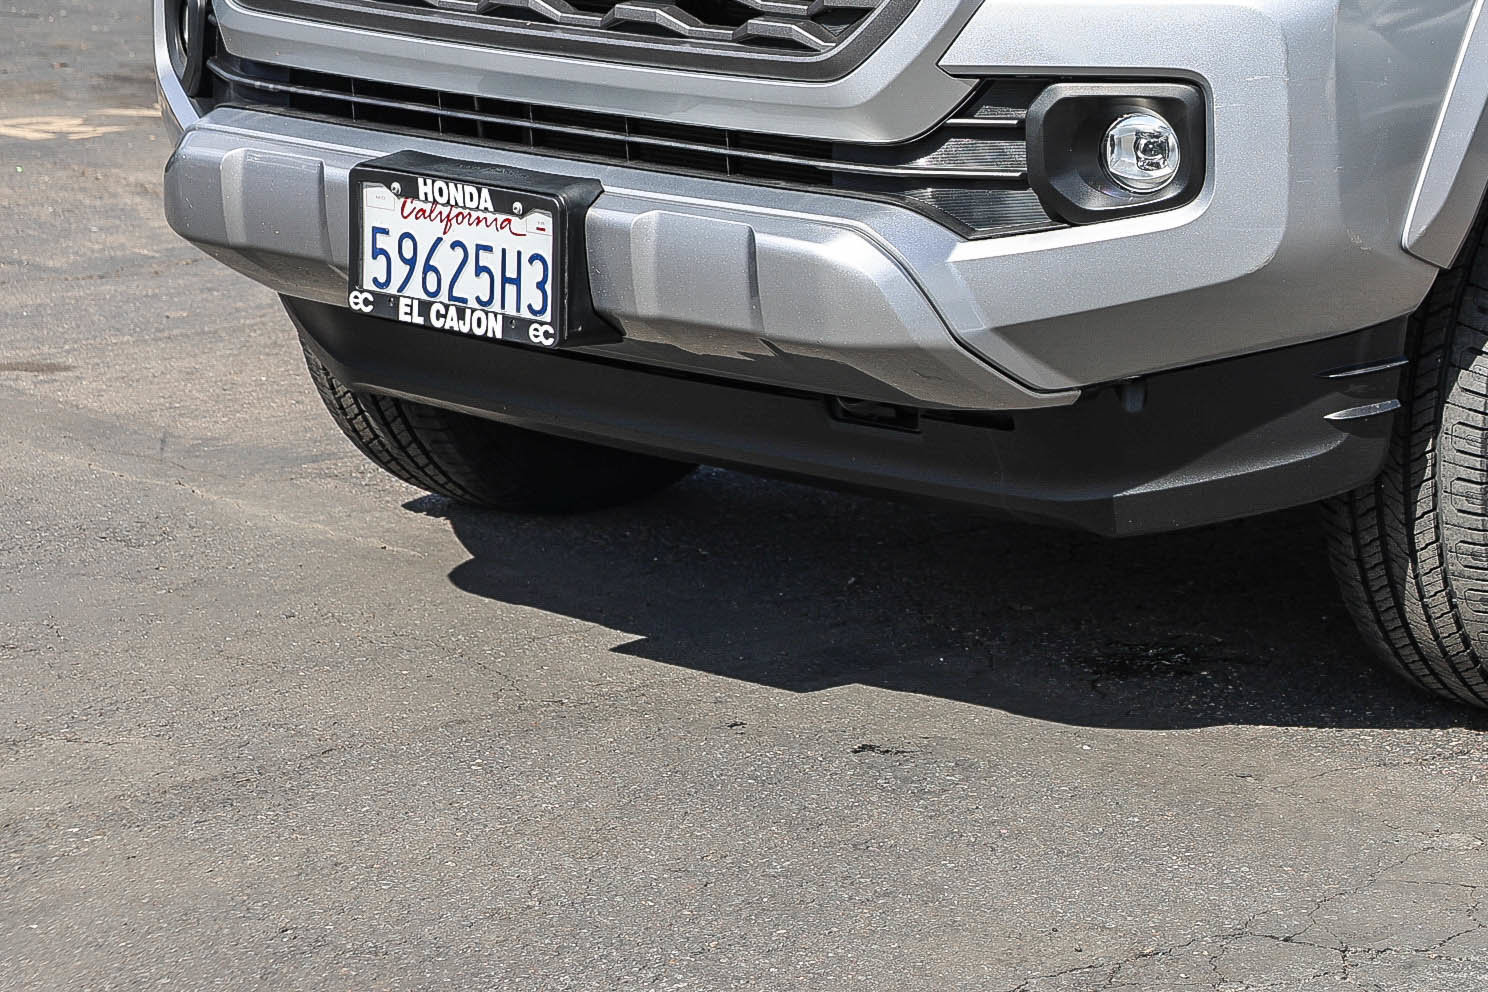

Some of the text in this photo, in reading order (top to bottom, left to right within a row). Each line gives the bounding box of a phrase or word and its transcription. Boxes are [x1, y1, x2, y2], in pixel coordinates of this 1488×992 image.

[418, 177, 494, 212] HONDA
[400, 196, 527, 236] California
[371, 225, 550, 318] 59625H3
[398, 297, 503, 339] EL CAJON
